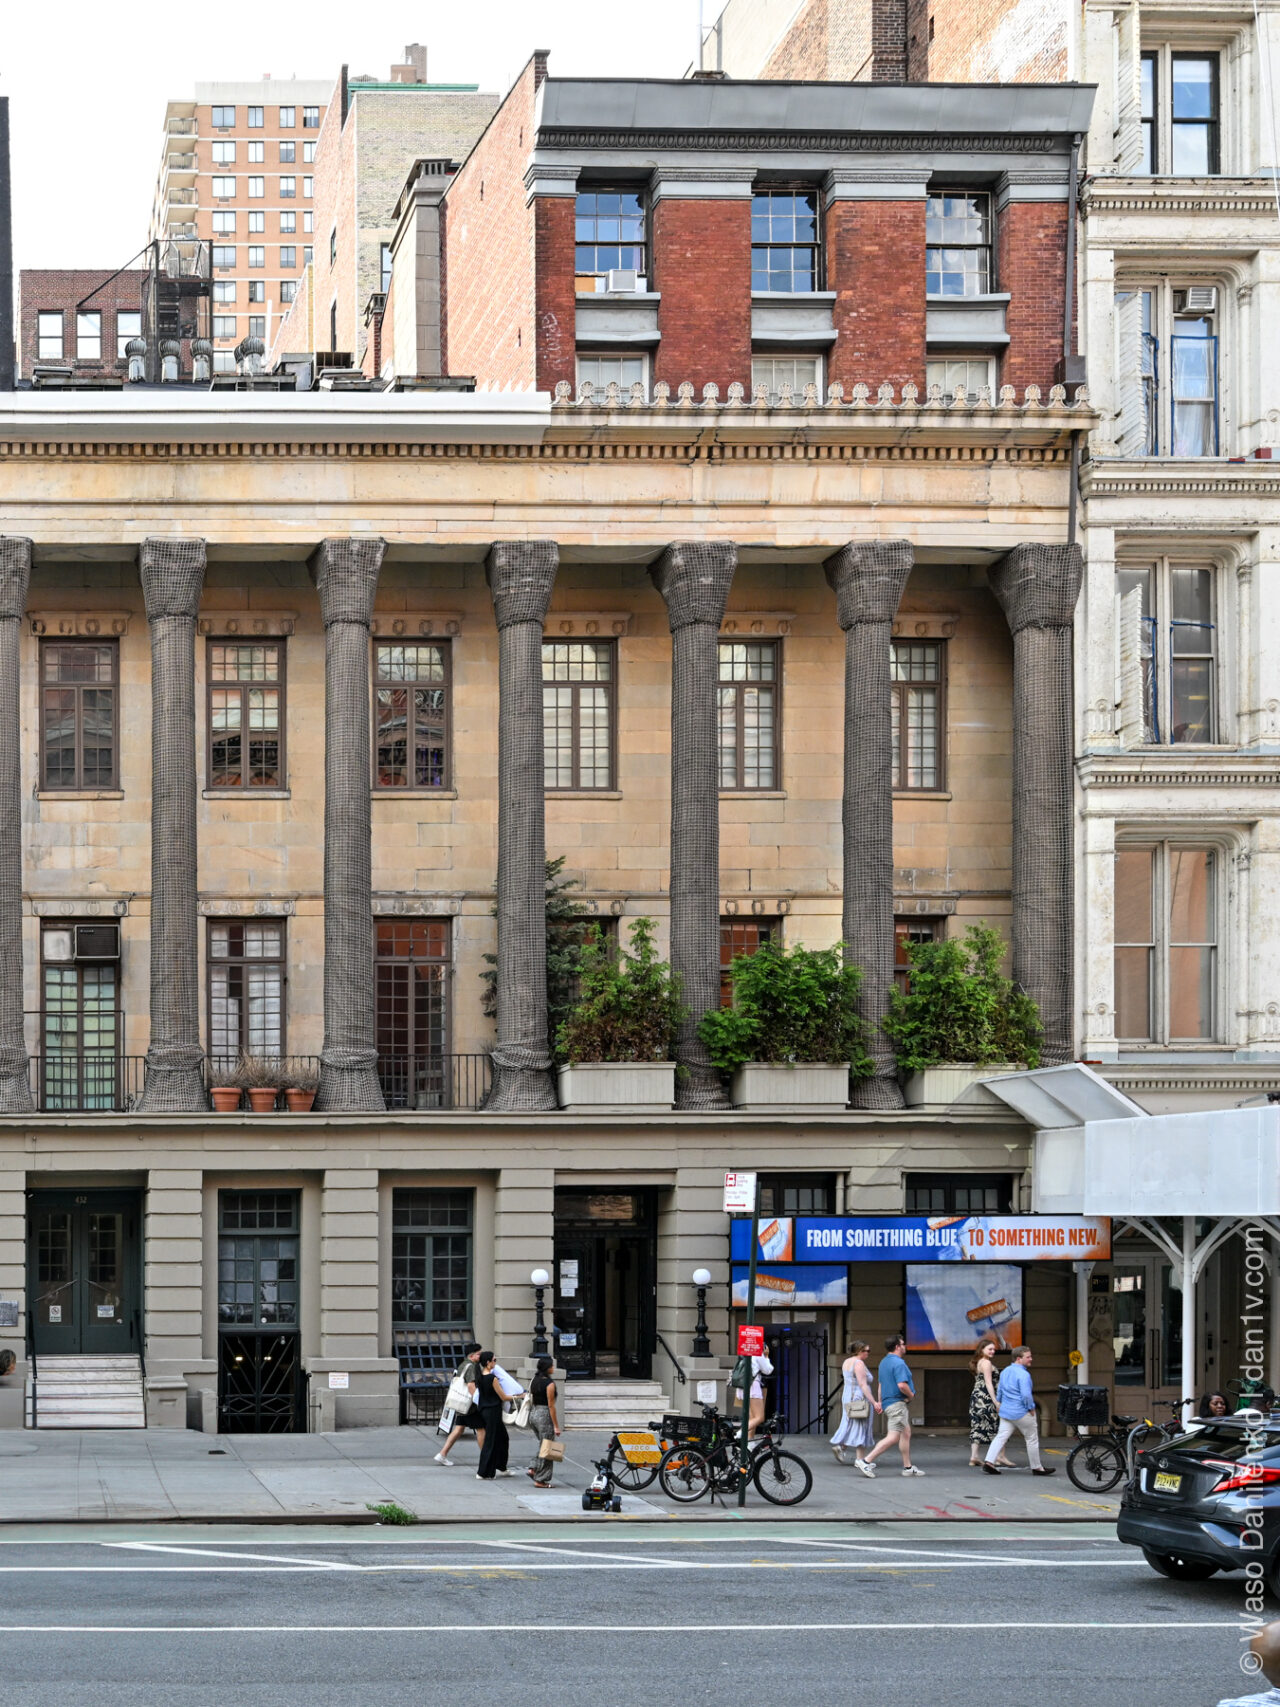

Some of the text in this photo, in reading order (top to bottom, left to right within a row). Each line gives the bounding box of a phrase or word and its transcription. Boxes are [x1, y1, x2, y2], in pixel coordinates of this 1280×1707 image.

[806, 1228, 1101, 1248] FROM SOMETHING BLUE TO SOMETHING NEW.
